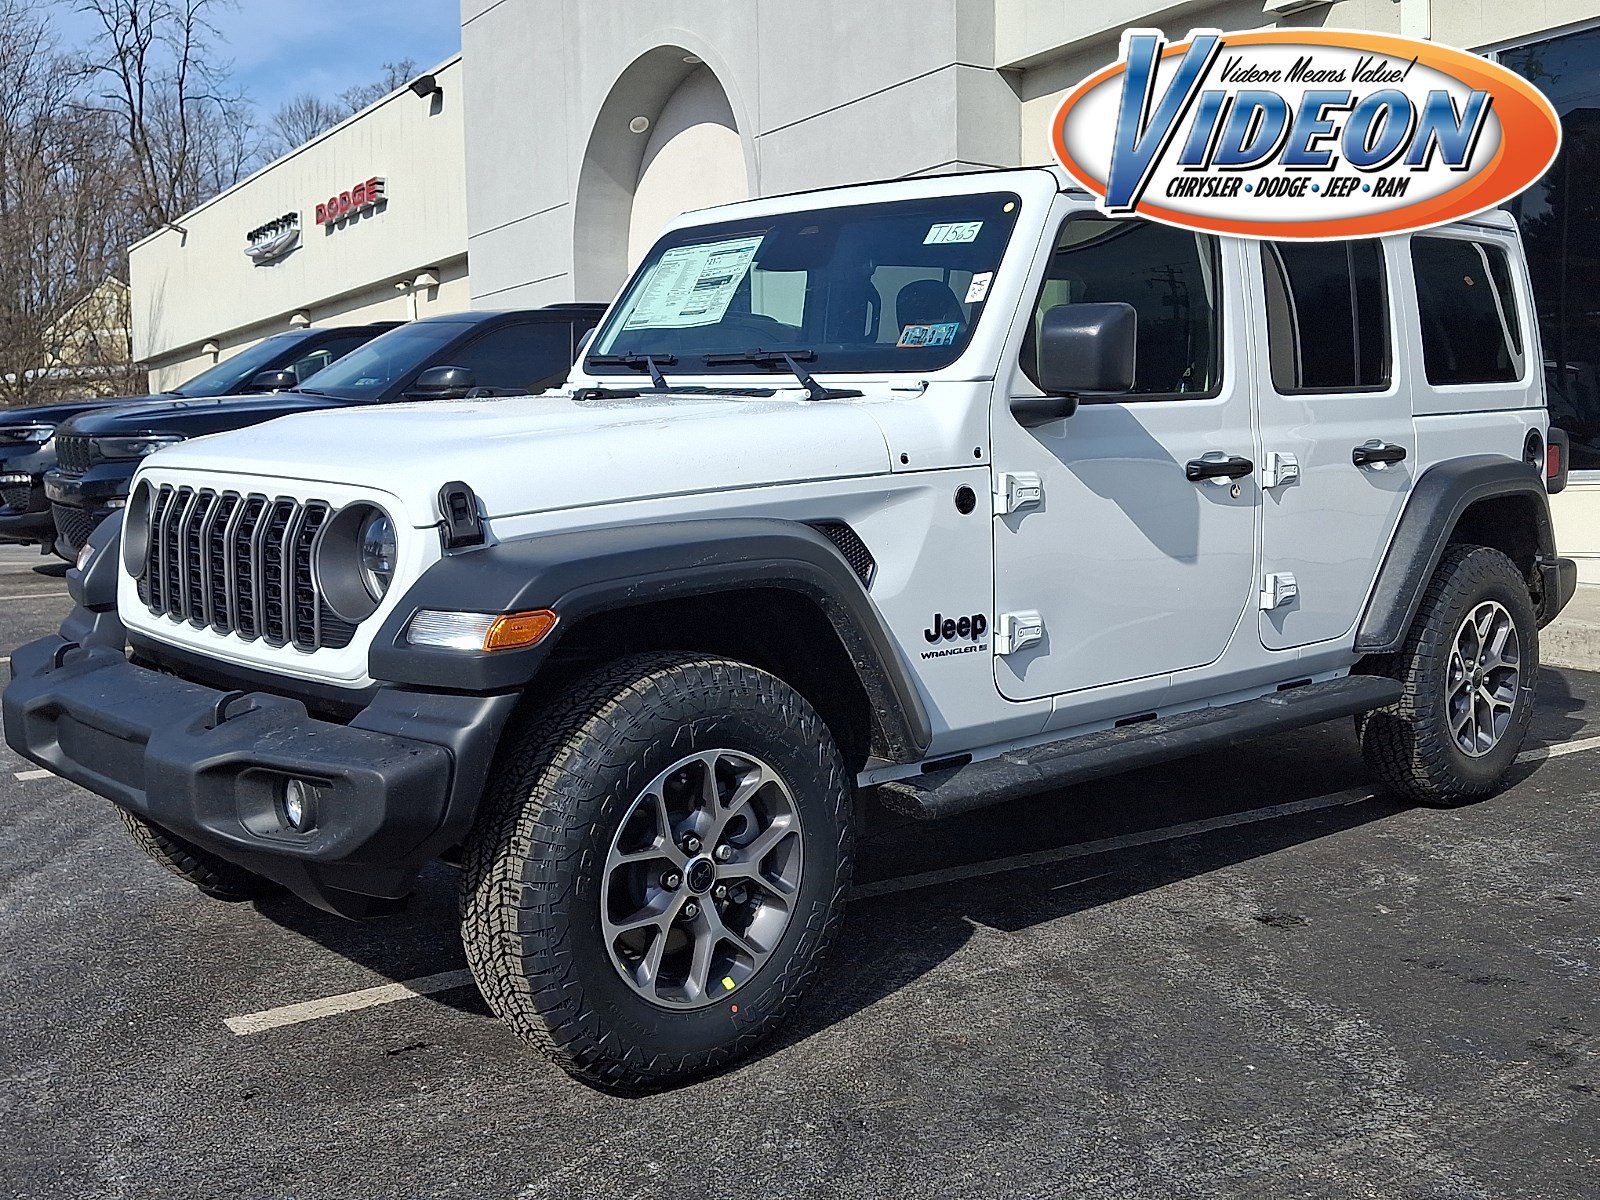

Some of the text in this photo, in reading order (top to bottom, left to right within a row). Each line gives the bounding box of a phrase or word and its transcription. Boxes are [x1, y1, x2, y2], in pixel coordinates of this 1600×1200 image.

[315, 176, 386, 225] DODGE
[923, 613, 988, 643] Jeep
[920, 645, 977, 660] WRANGLER
[730, 900, 827, 1031] NEXEN
